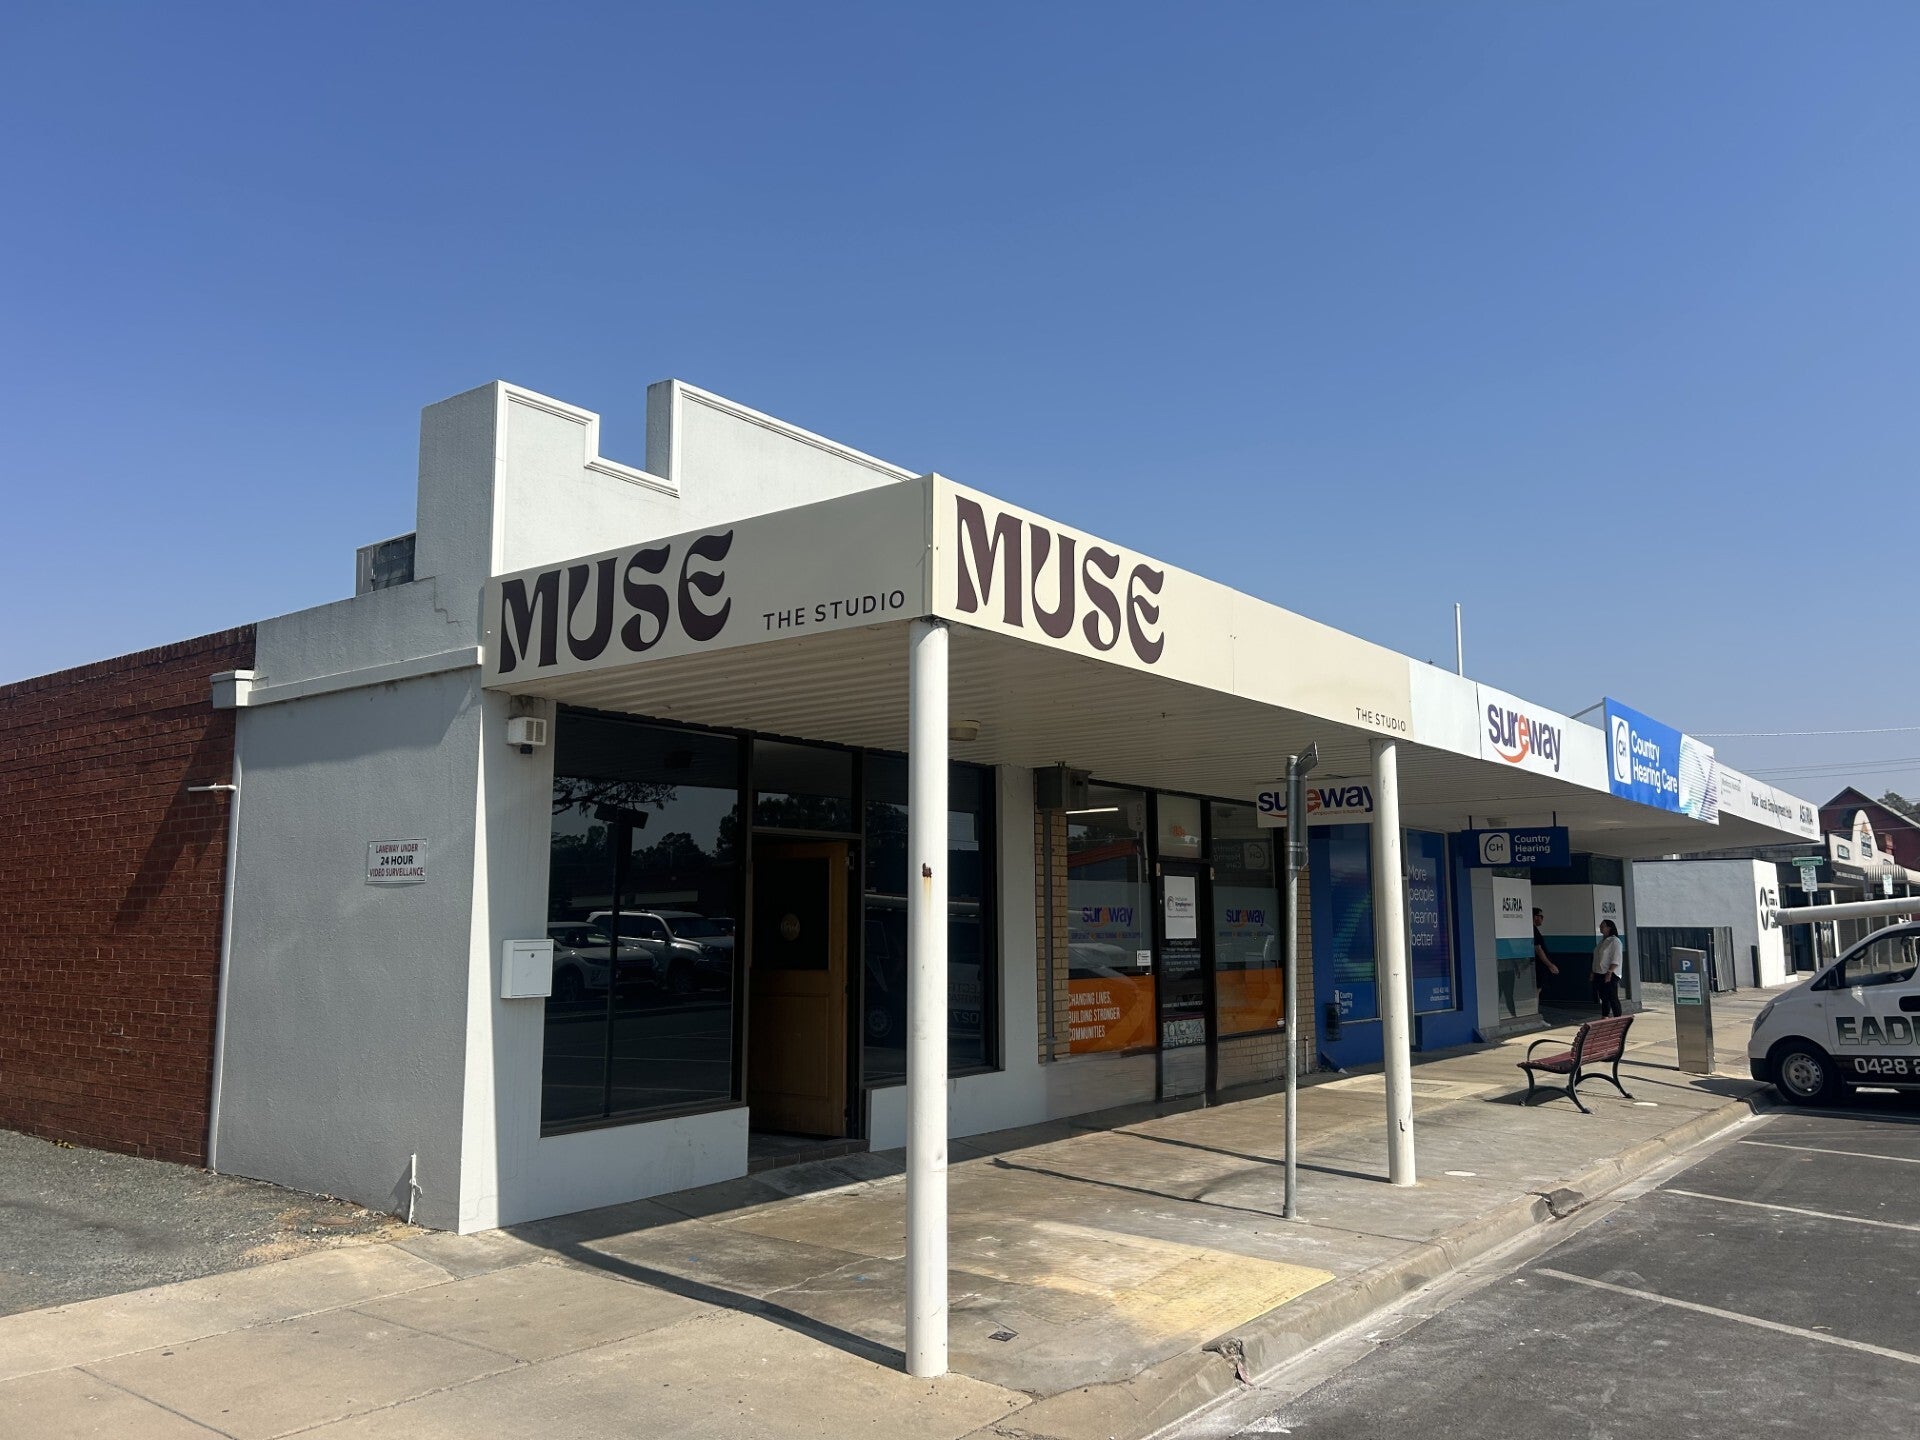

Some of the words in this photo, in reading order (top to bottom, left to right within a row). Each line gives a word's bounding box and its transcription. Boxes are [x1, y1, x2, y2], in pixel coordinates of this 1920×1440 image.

[955, 495, 1165, 664] MUSE
[498, 529, 734, 674] MUSE
[763, 607, 806, 631] THE
[814, 590, 906, 622] STUDIO
[1356, 707, 1373, 724] THE
[1375, 713, 1406, 732] STUDIO
[1487, 704, 1561, 773] sureway
[1631, 730, 1660, 768] Country
[1632, 757, 1661, 794] Hearing
[1661, 768, 1678, 794] Care
[1258, 785, 1374, 813] sueway
[1488, 843, 1504, 852] CH
[1514, 834, 1551, 845] Country
[375, 844, 399, 853] LANEWAY
[400, 844, 418, 853] UNDER
[1515, 845, 1551, 854] Hearing
[380, 856, 390, 866] 24
[391, 855, 414, 866] HOUR
[1515, 854, 1536, 862] Care
[369, 869, 385, 877] VIDEO
[385, 867, 424, 877] SURVEILLANCE
[1408, 864, 1427, 882] More
[1409, 887, 1435, 904] people
[1502, 897, 1523, 912] ASURIA
[1082, 906, 1133, 928] sureway
[1226, 908, 1265, 928] sureway
[1411, 930, 1435, 947] better
[1682, 960, 1691, 971] P
[1093, 1007, 1120, 1021] STRONGER
[1069, 1025, 1106, 1041] COMMUNITIES
[1854, 1057, 1909, 1075] 0428
